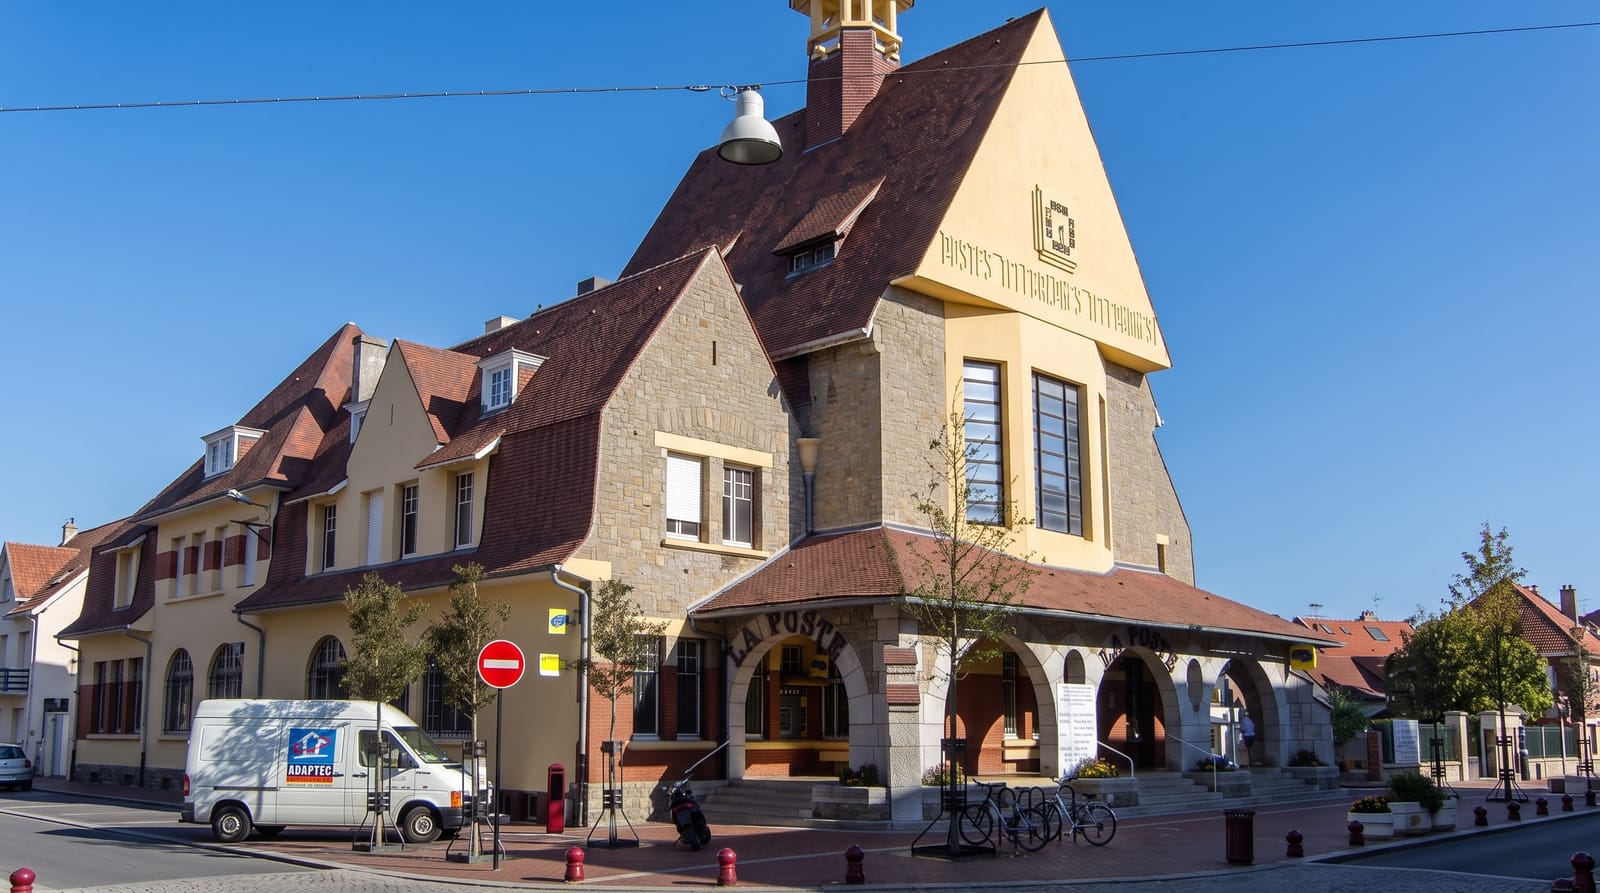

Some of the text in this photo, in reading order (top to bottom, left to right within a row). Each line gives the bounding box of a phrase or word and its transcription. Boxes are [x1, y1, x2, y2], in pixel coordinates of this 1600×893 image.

[729, 611, 848, 668] LA POSTE
[288, 764, 332, 776] ADAPTEC
